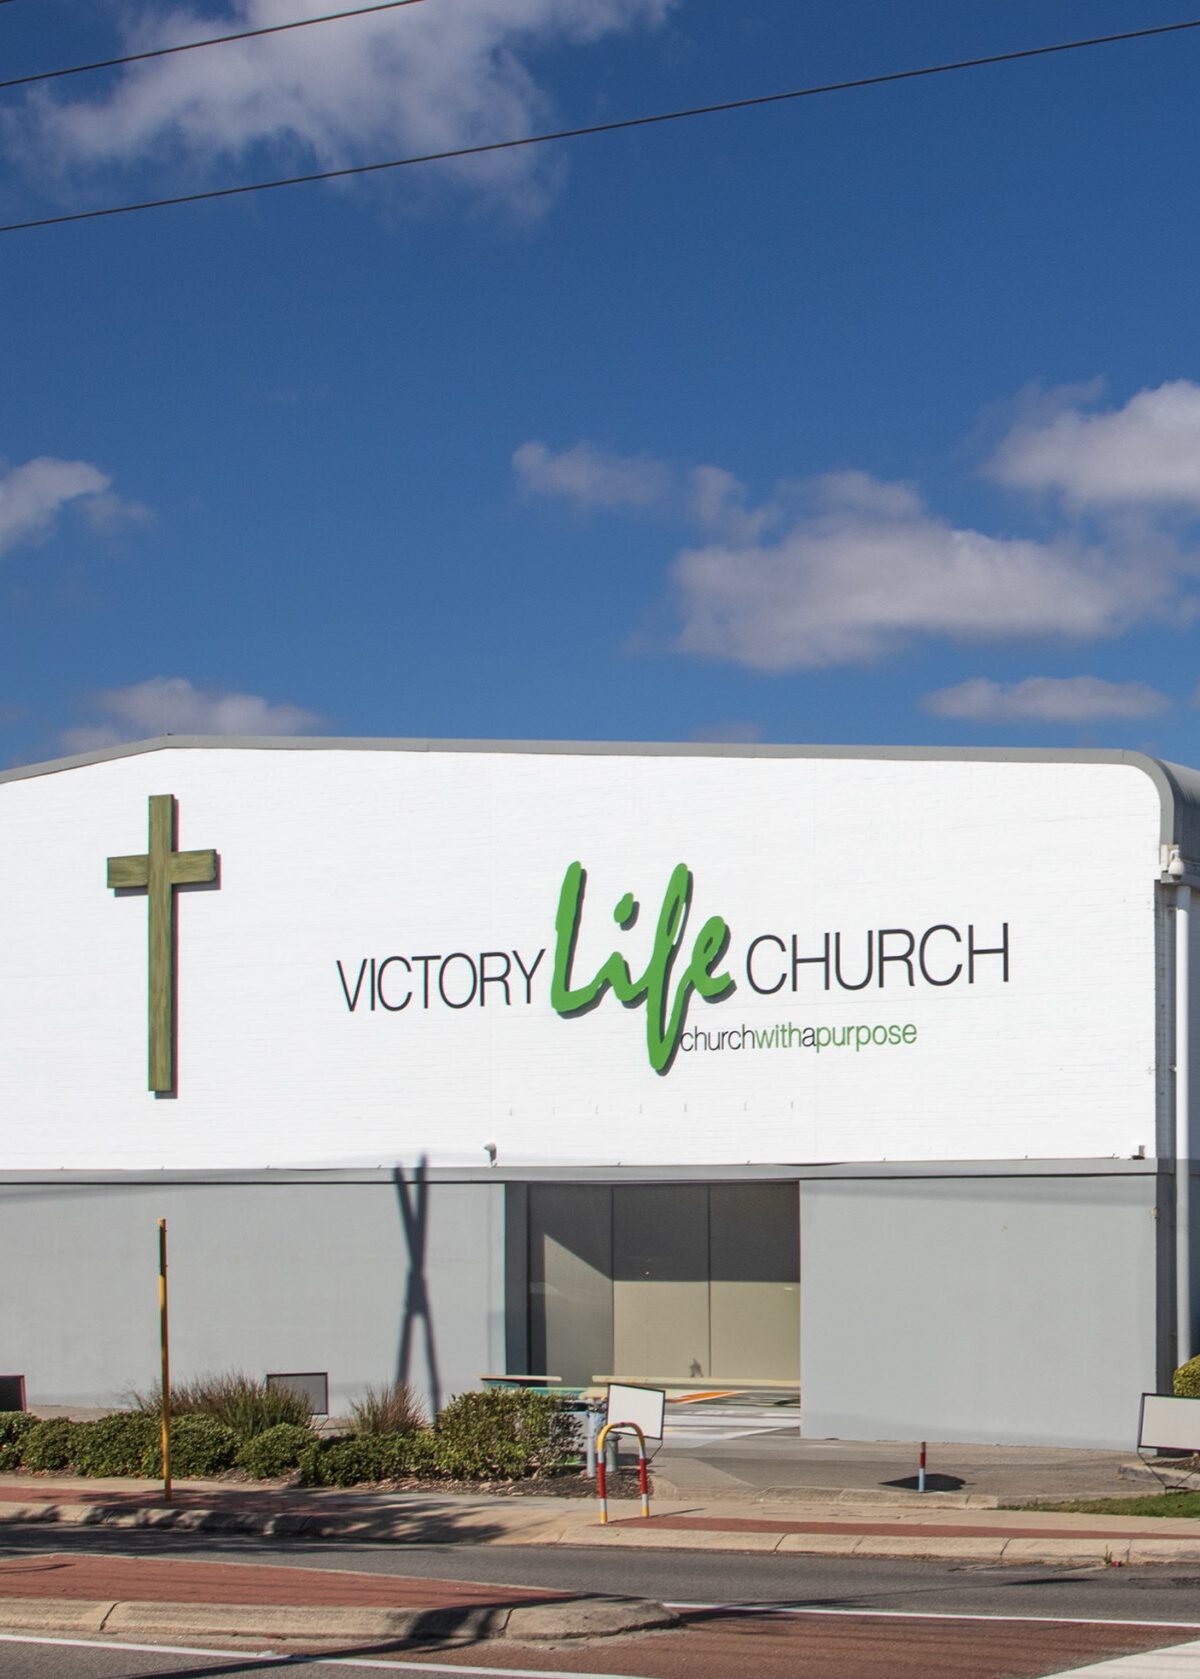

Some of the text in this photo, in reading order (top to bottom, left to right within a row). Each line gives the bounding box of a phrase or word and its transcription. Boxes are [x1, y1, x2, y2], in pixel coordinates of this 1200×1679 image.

[336, 861, 1010, 1077] VICTORY Life CHURCH
[680, 1020, 918, 1053] churchwithapurpose
